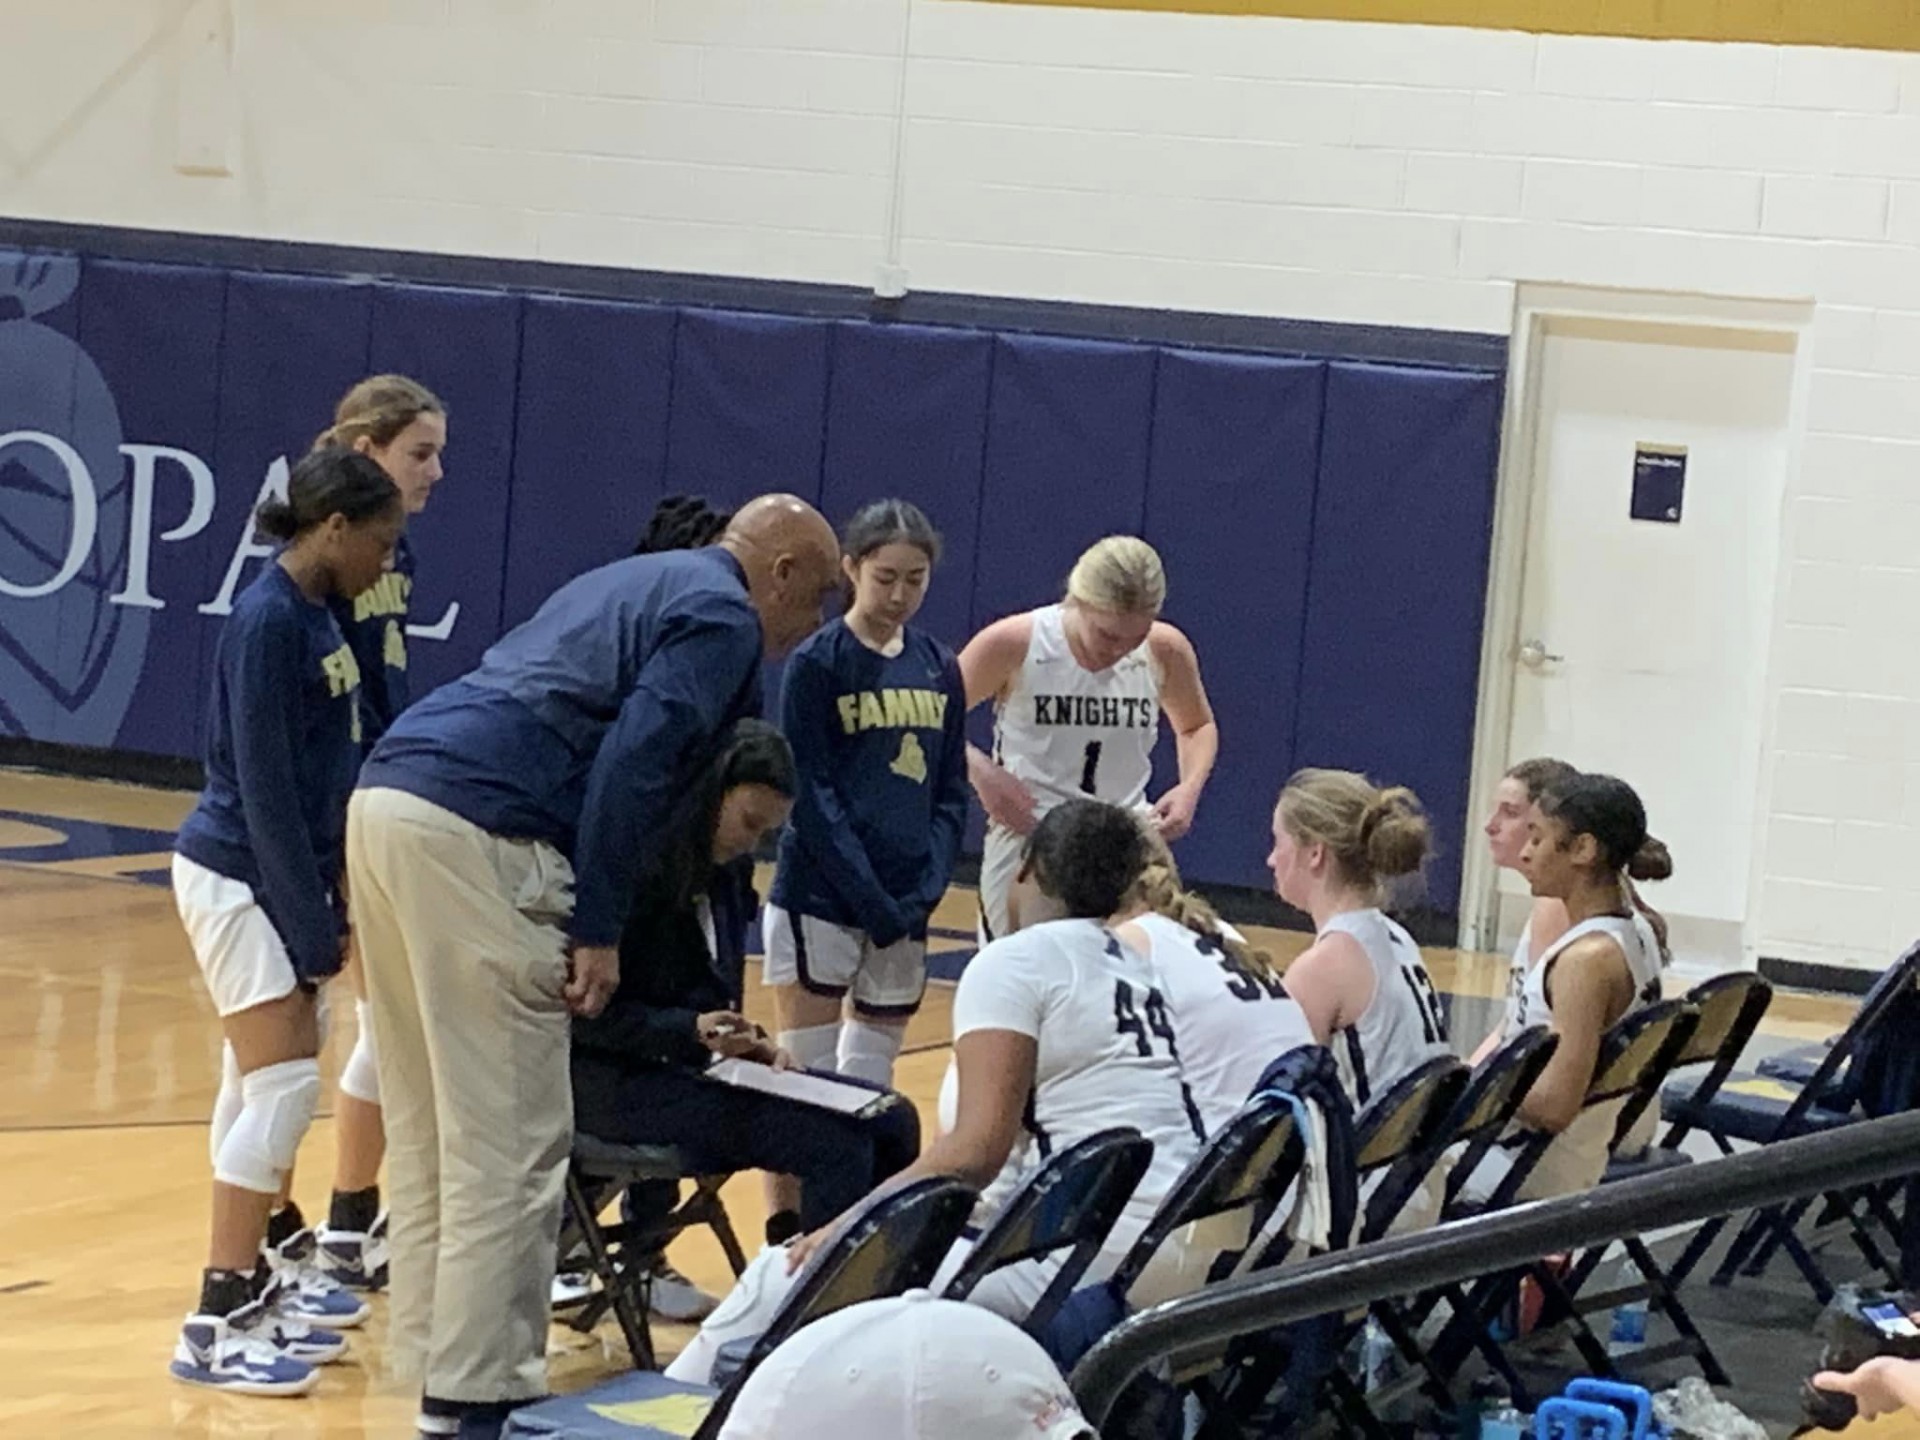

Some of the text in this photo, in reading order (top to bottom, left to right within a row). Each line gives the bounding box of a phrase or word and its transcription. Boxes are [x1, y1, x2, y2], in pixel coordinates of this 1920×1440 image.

[1033, 694, 1152, 729] KNIGHTS
[1080, 740, 1102, 795] 1
[1113, 977, 1179, 1061] 44
